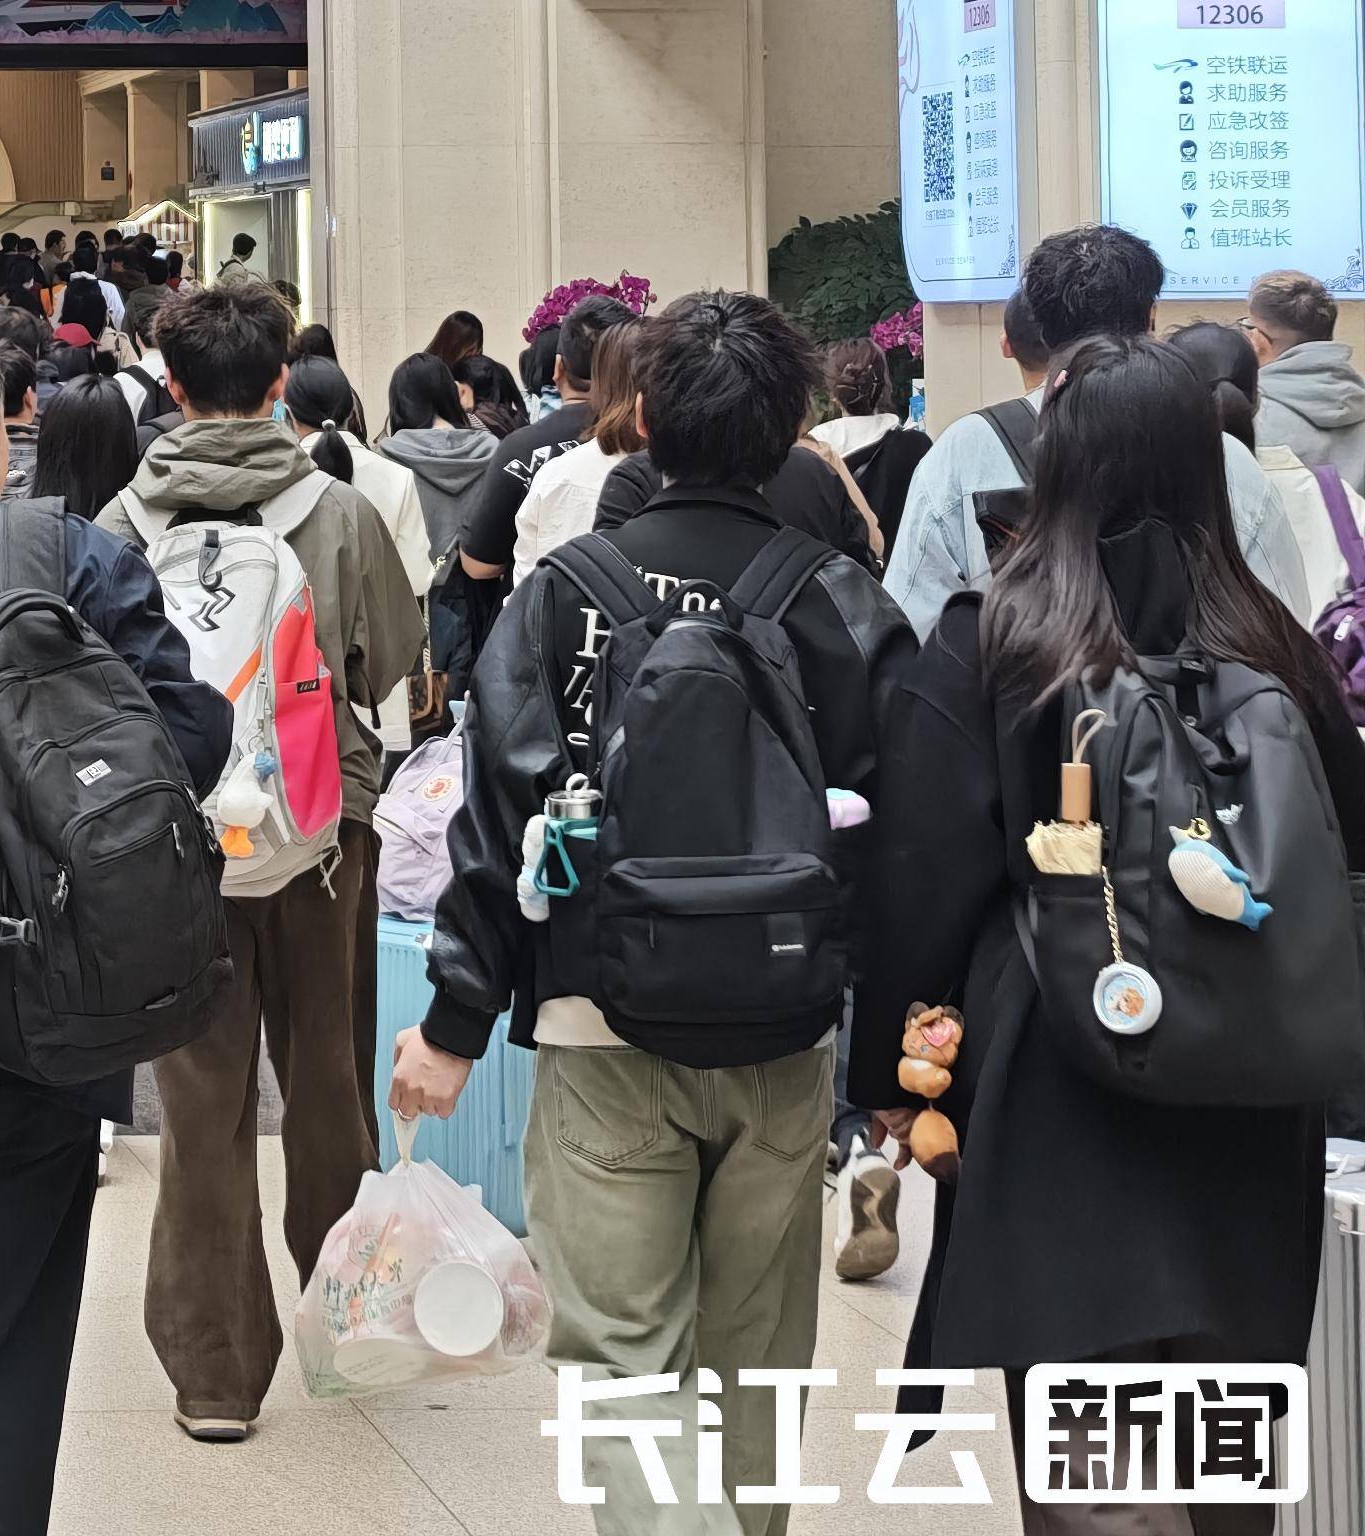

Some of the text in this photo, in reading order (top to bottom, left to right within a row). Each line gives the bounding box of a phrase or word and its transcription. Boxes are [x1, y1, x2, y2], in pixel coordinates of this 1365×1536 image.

[969, 4, 990, 27] 12306
[1195, 3, 1265, 26] 12306
[1207, 55, 1288, 75] 空铁联运
[1207, 83, 1288, 103] 求助服务
[1208, 111, 1289, 131] 应急改签
[1208, 140, 1290, 160] 咨询服务
[1209, 170, 1291, 190] 投诉受理
[1210, 199, 1291, 219] 会员服务
[1210, 228, 1292, 248] 值班站长
[1170, 276, 1240, 285] SERVICE
